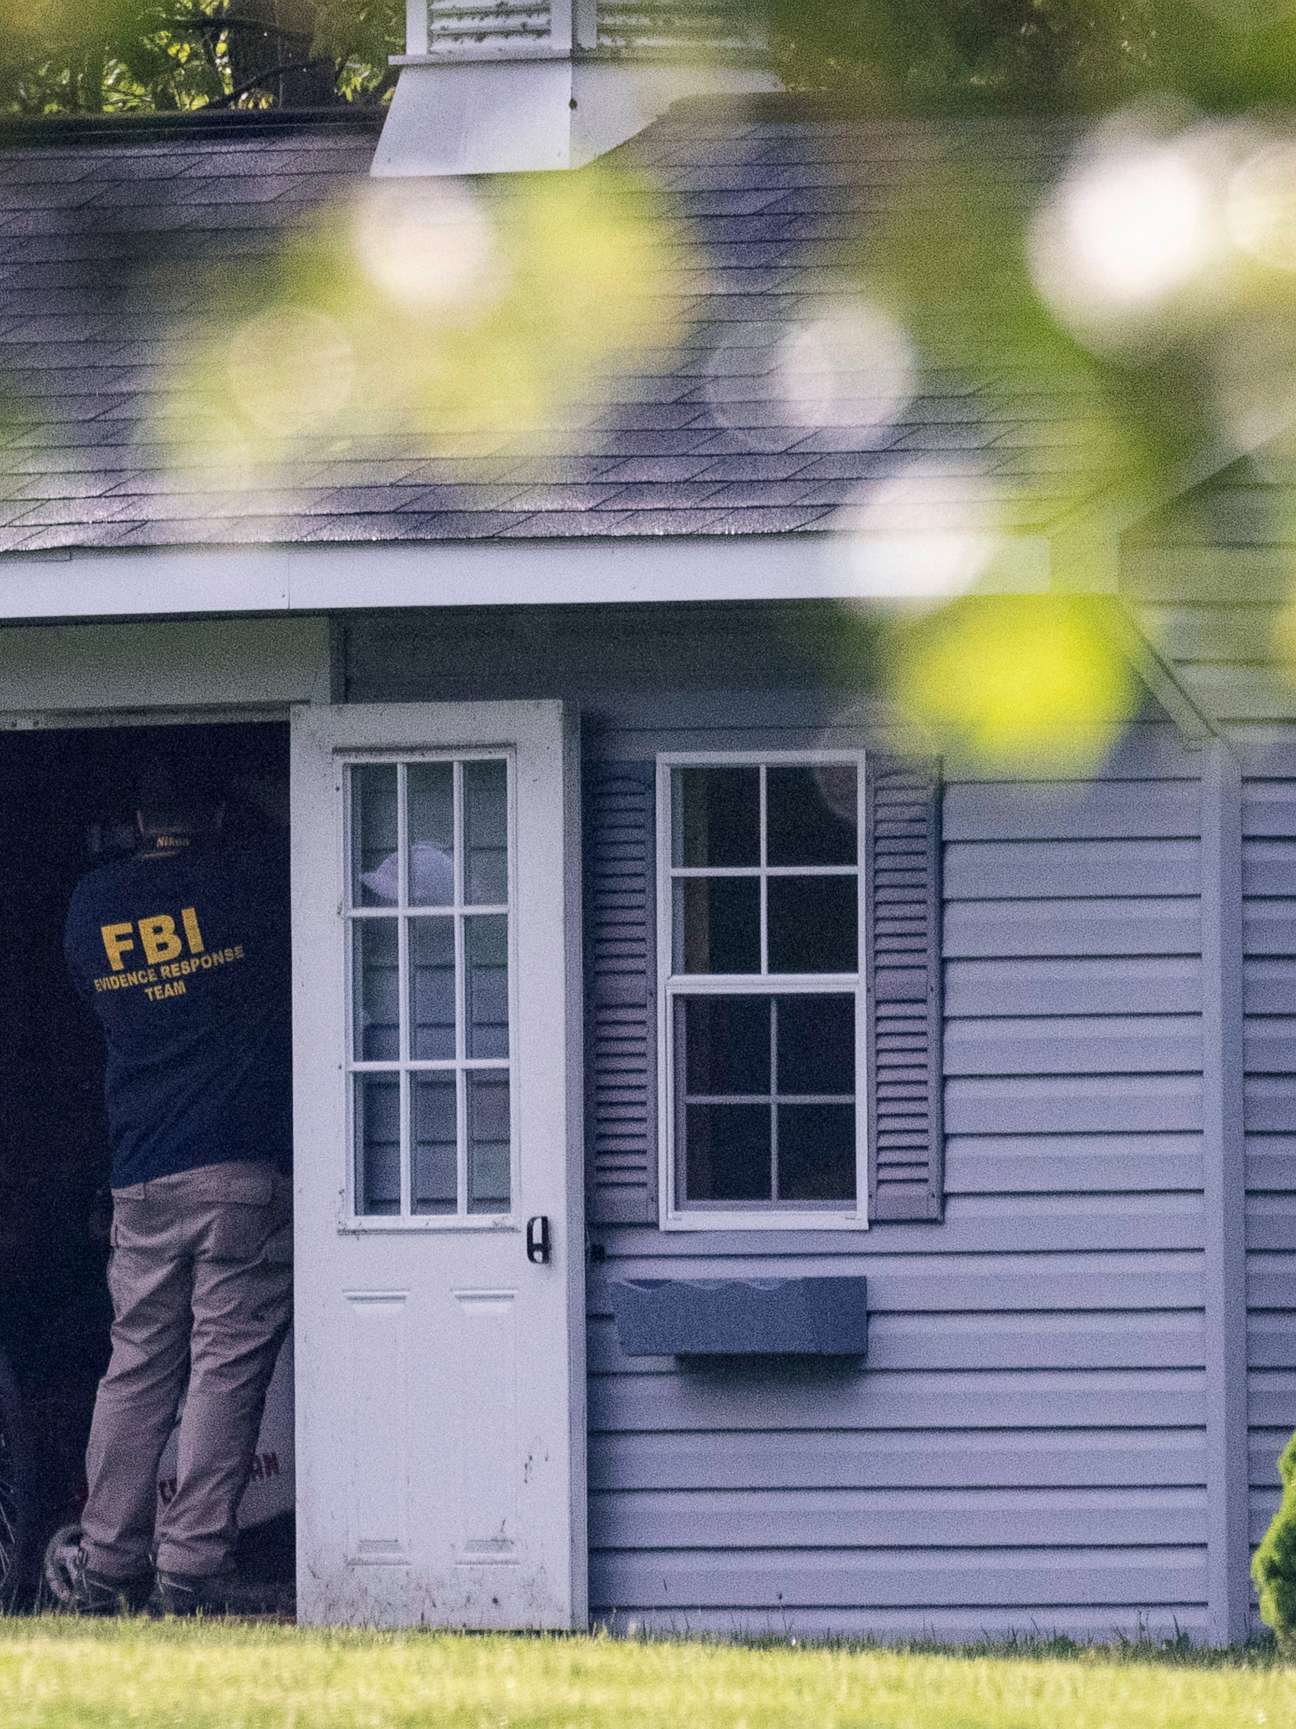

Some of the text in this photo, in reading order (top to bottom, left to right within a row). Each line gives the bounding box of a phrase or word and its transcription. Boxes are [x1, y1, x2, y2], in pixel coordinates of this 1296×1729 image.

[101, 907, 205, 971] FBI
[94, 945, 244, 992] EVIDENCE RESPONSE
[145, 980, 186, 1001] TEAM
